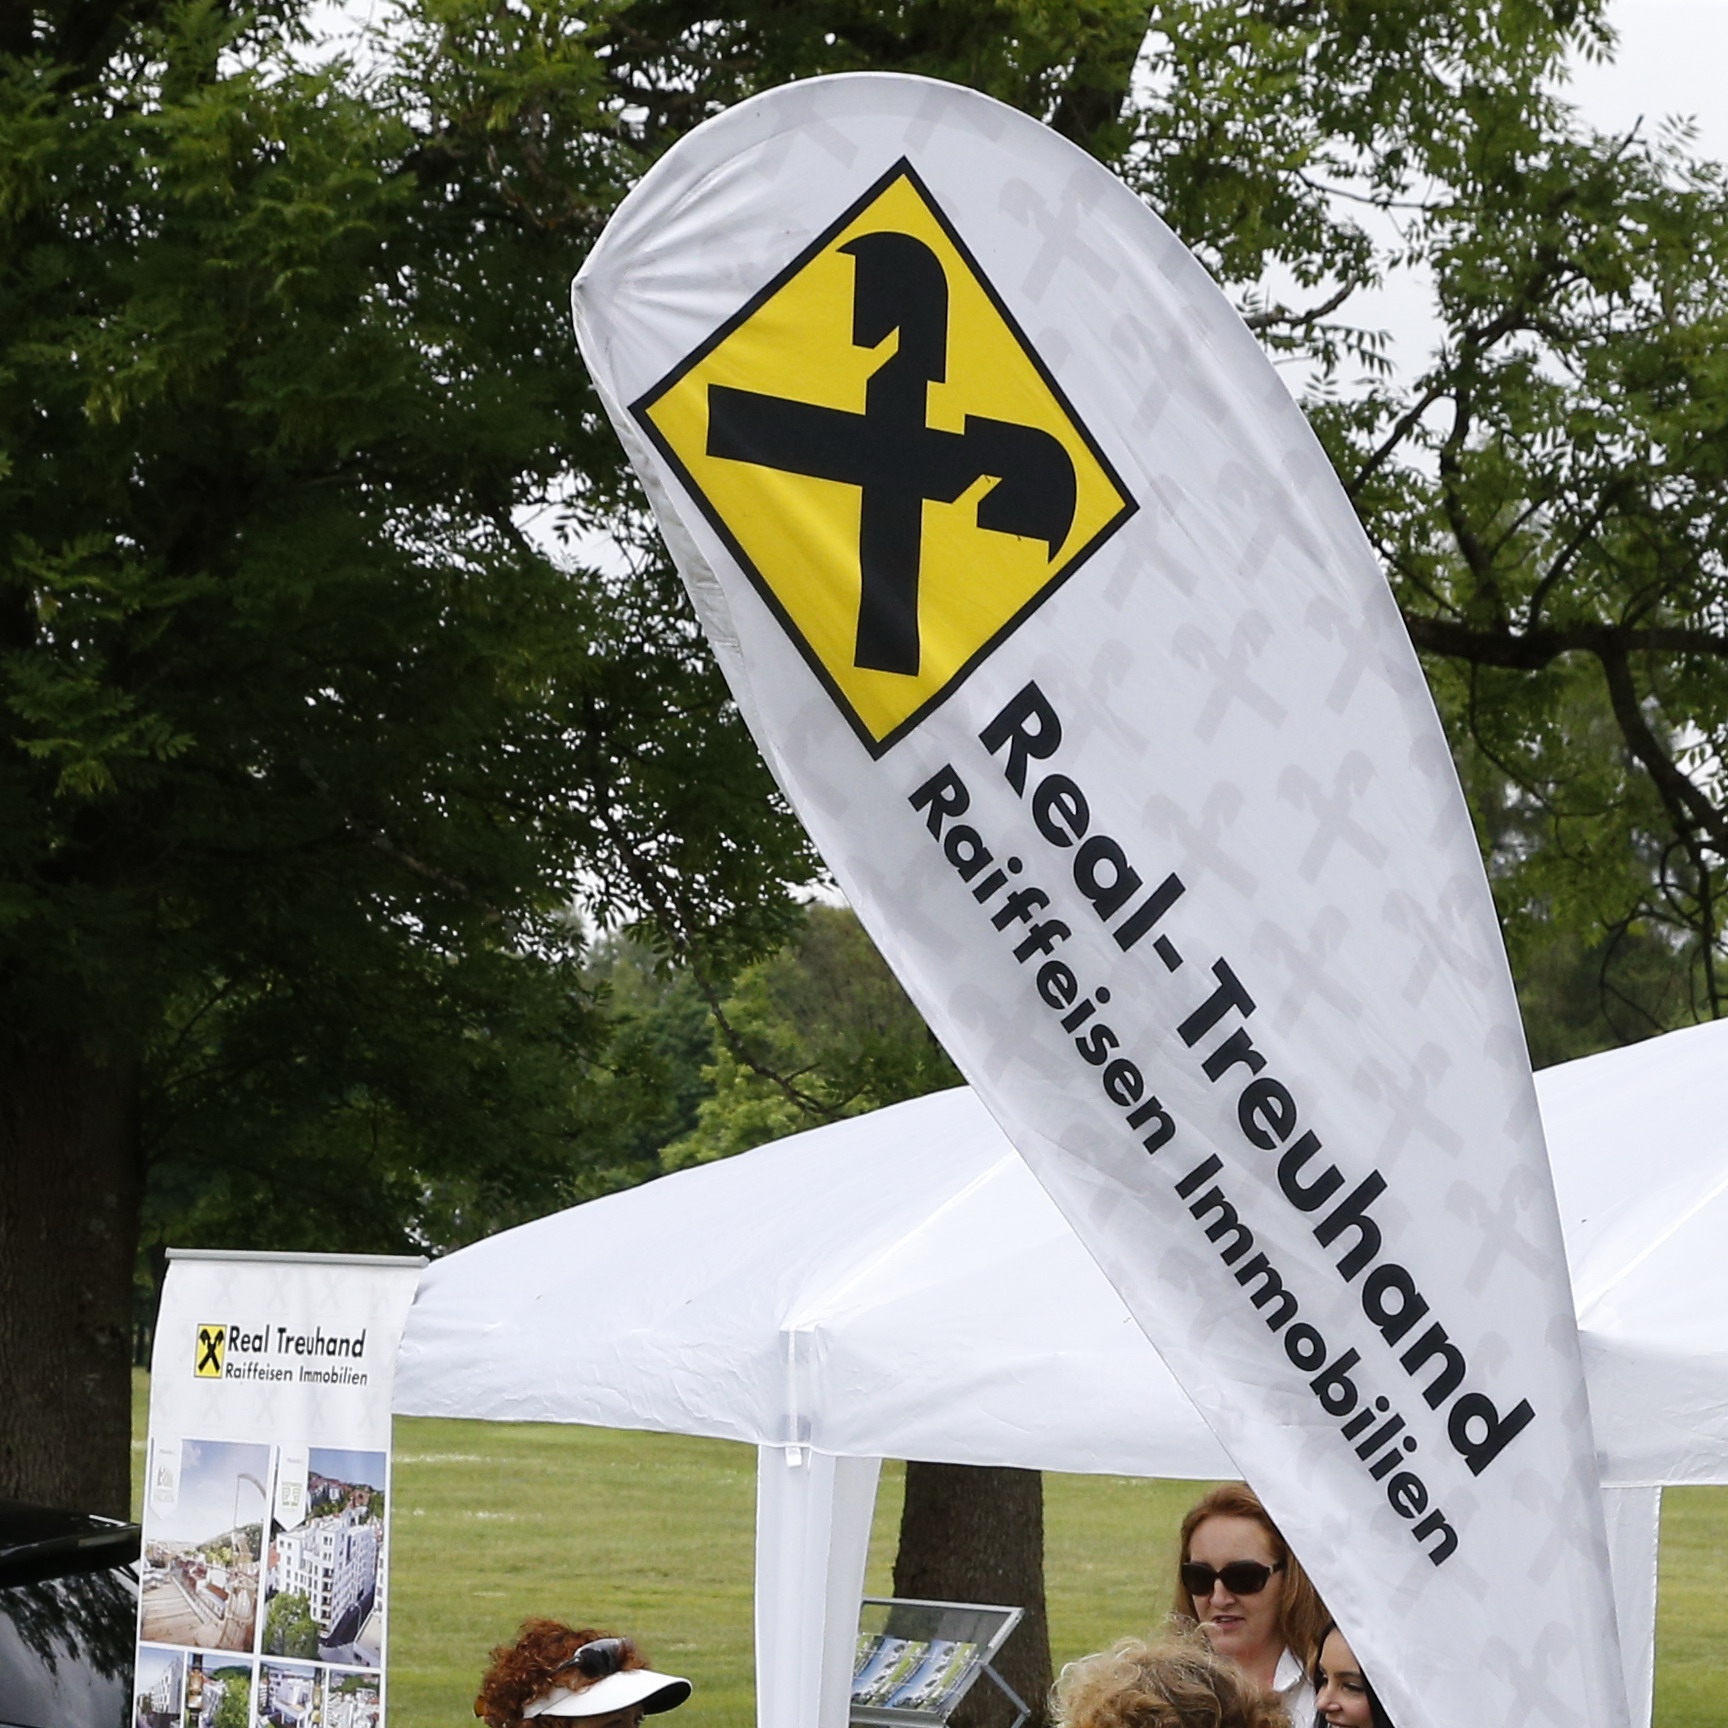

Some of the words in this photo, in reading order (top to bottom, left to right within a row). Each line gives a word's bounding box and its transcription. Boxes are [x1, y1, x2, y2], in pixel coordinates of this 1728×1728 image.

[908, 763, 1178, 1156] Raiffeisen
[1175, 1154, 1461, 1567] Immobilien
[978, 680, 1536, 1477] Real-Treuhand
[225, 1363, 293, 1383] Raiffeisen
[299, 1365, 368, 1386] Immobilien
[228, 1325, 270, 1354] Real
[277, 1326, 367, 1358] Treuhand
